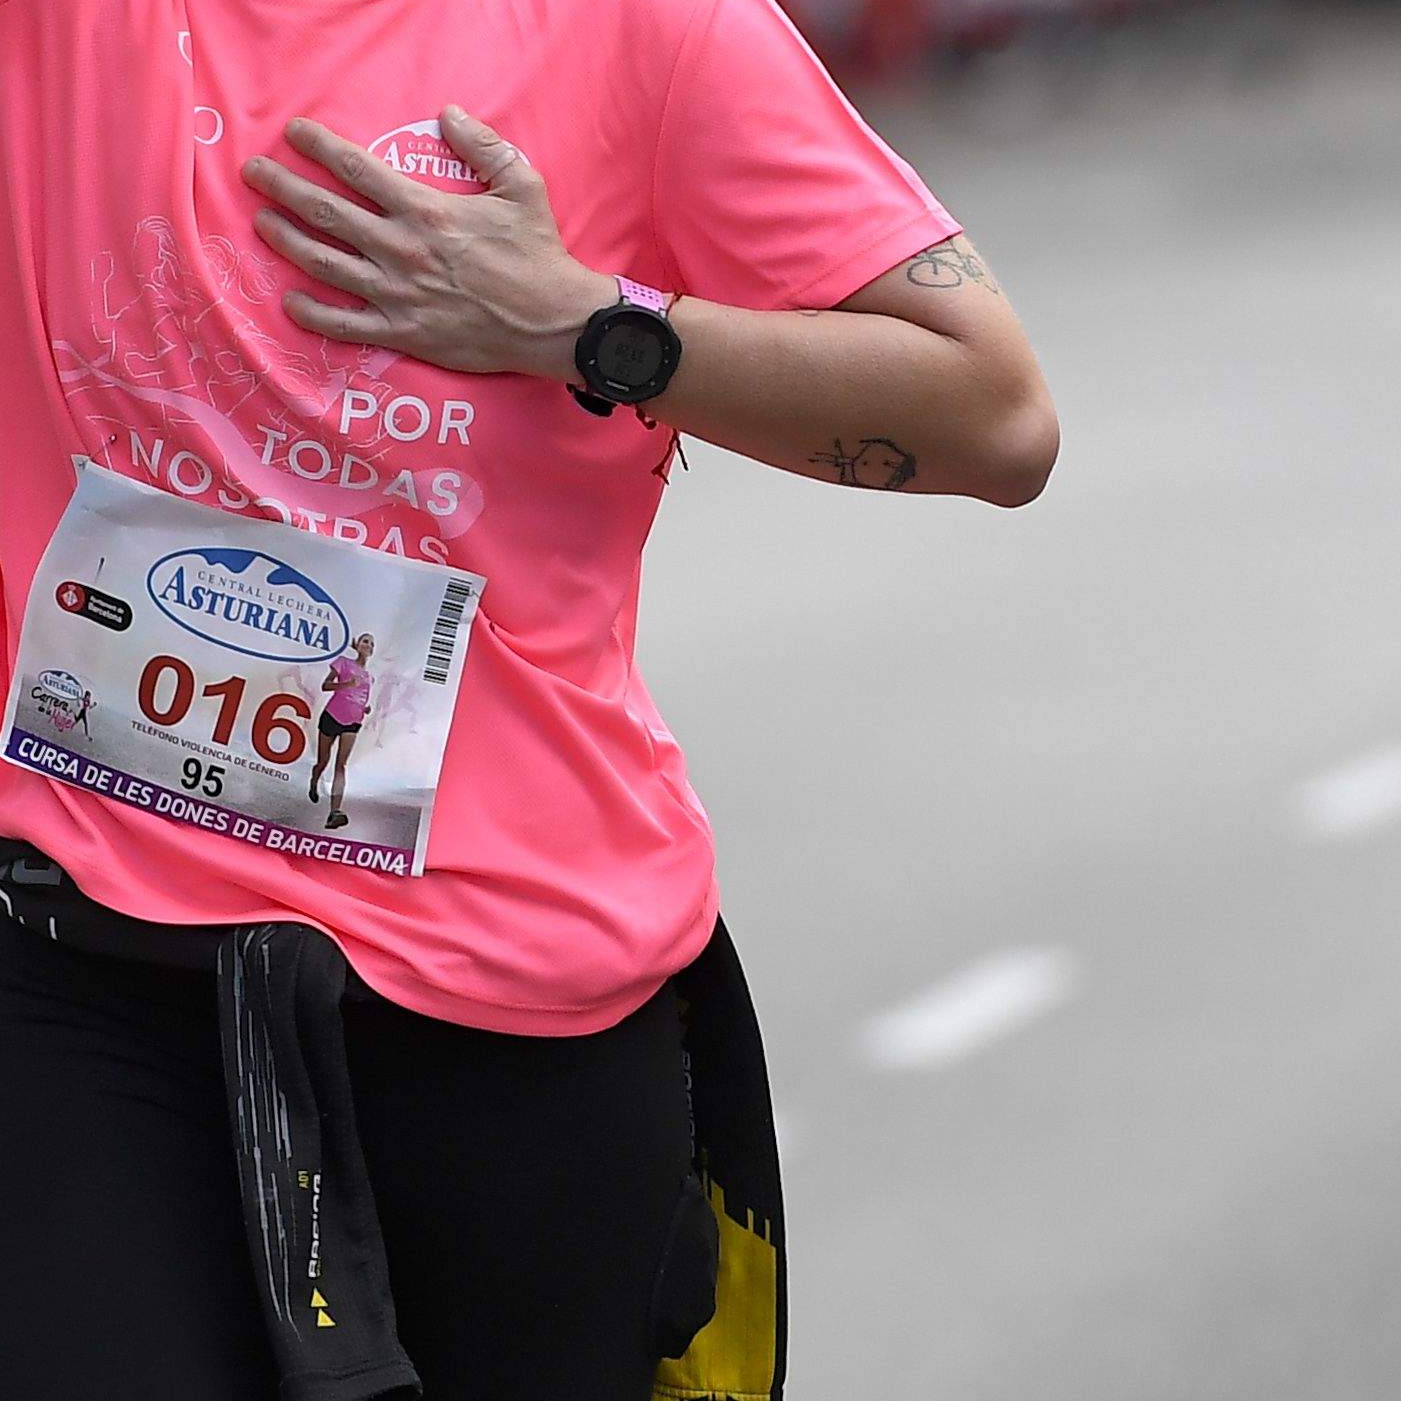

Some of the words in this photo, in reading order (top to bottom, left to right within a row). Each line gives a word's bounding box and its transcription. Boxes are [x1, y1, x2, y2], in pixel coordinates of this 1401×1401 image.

[339, 388, 476, 446] POR
[256, 423, 462, 517] TODAS
[158, 565, 331, 652] ASTURIANA
[197, 570, 261, 598] CENTRAL
[268, 591, 331, 621] LECHERA
[138, 655, 312, 765] 016
[131, 720, 180, 746] TELÉFONO
[181, 739, 232, 763] VIOLENCIA
[234, 756, 247, 768] DE
[249, 760, 290, 782] GÉNERO
[181, 757, 226, 798] 95
[18, 737, 79, 779] CURSA
[82, 763, 113, 791] DE
[113, 776, 153, 806] LES
[155, 791, 230, 832] DONES
[232, 817, 264, 844] DE
[265, 829, 406, 876] BARCELONA
